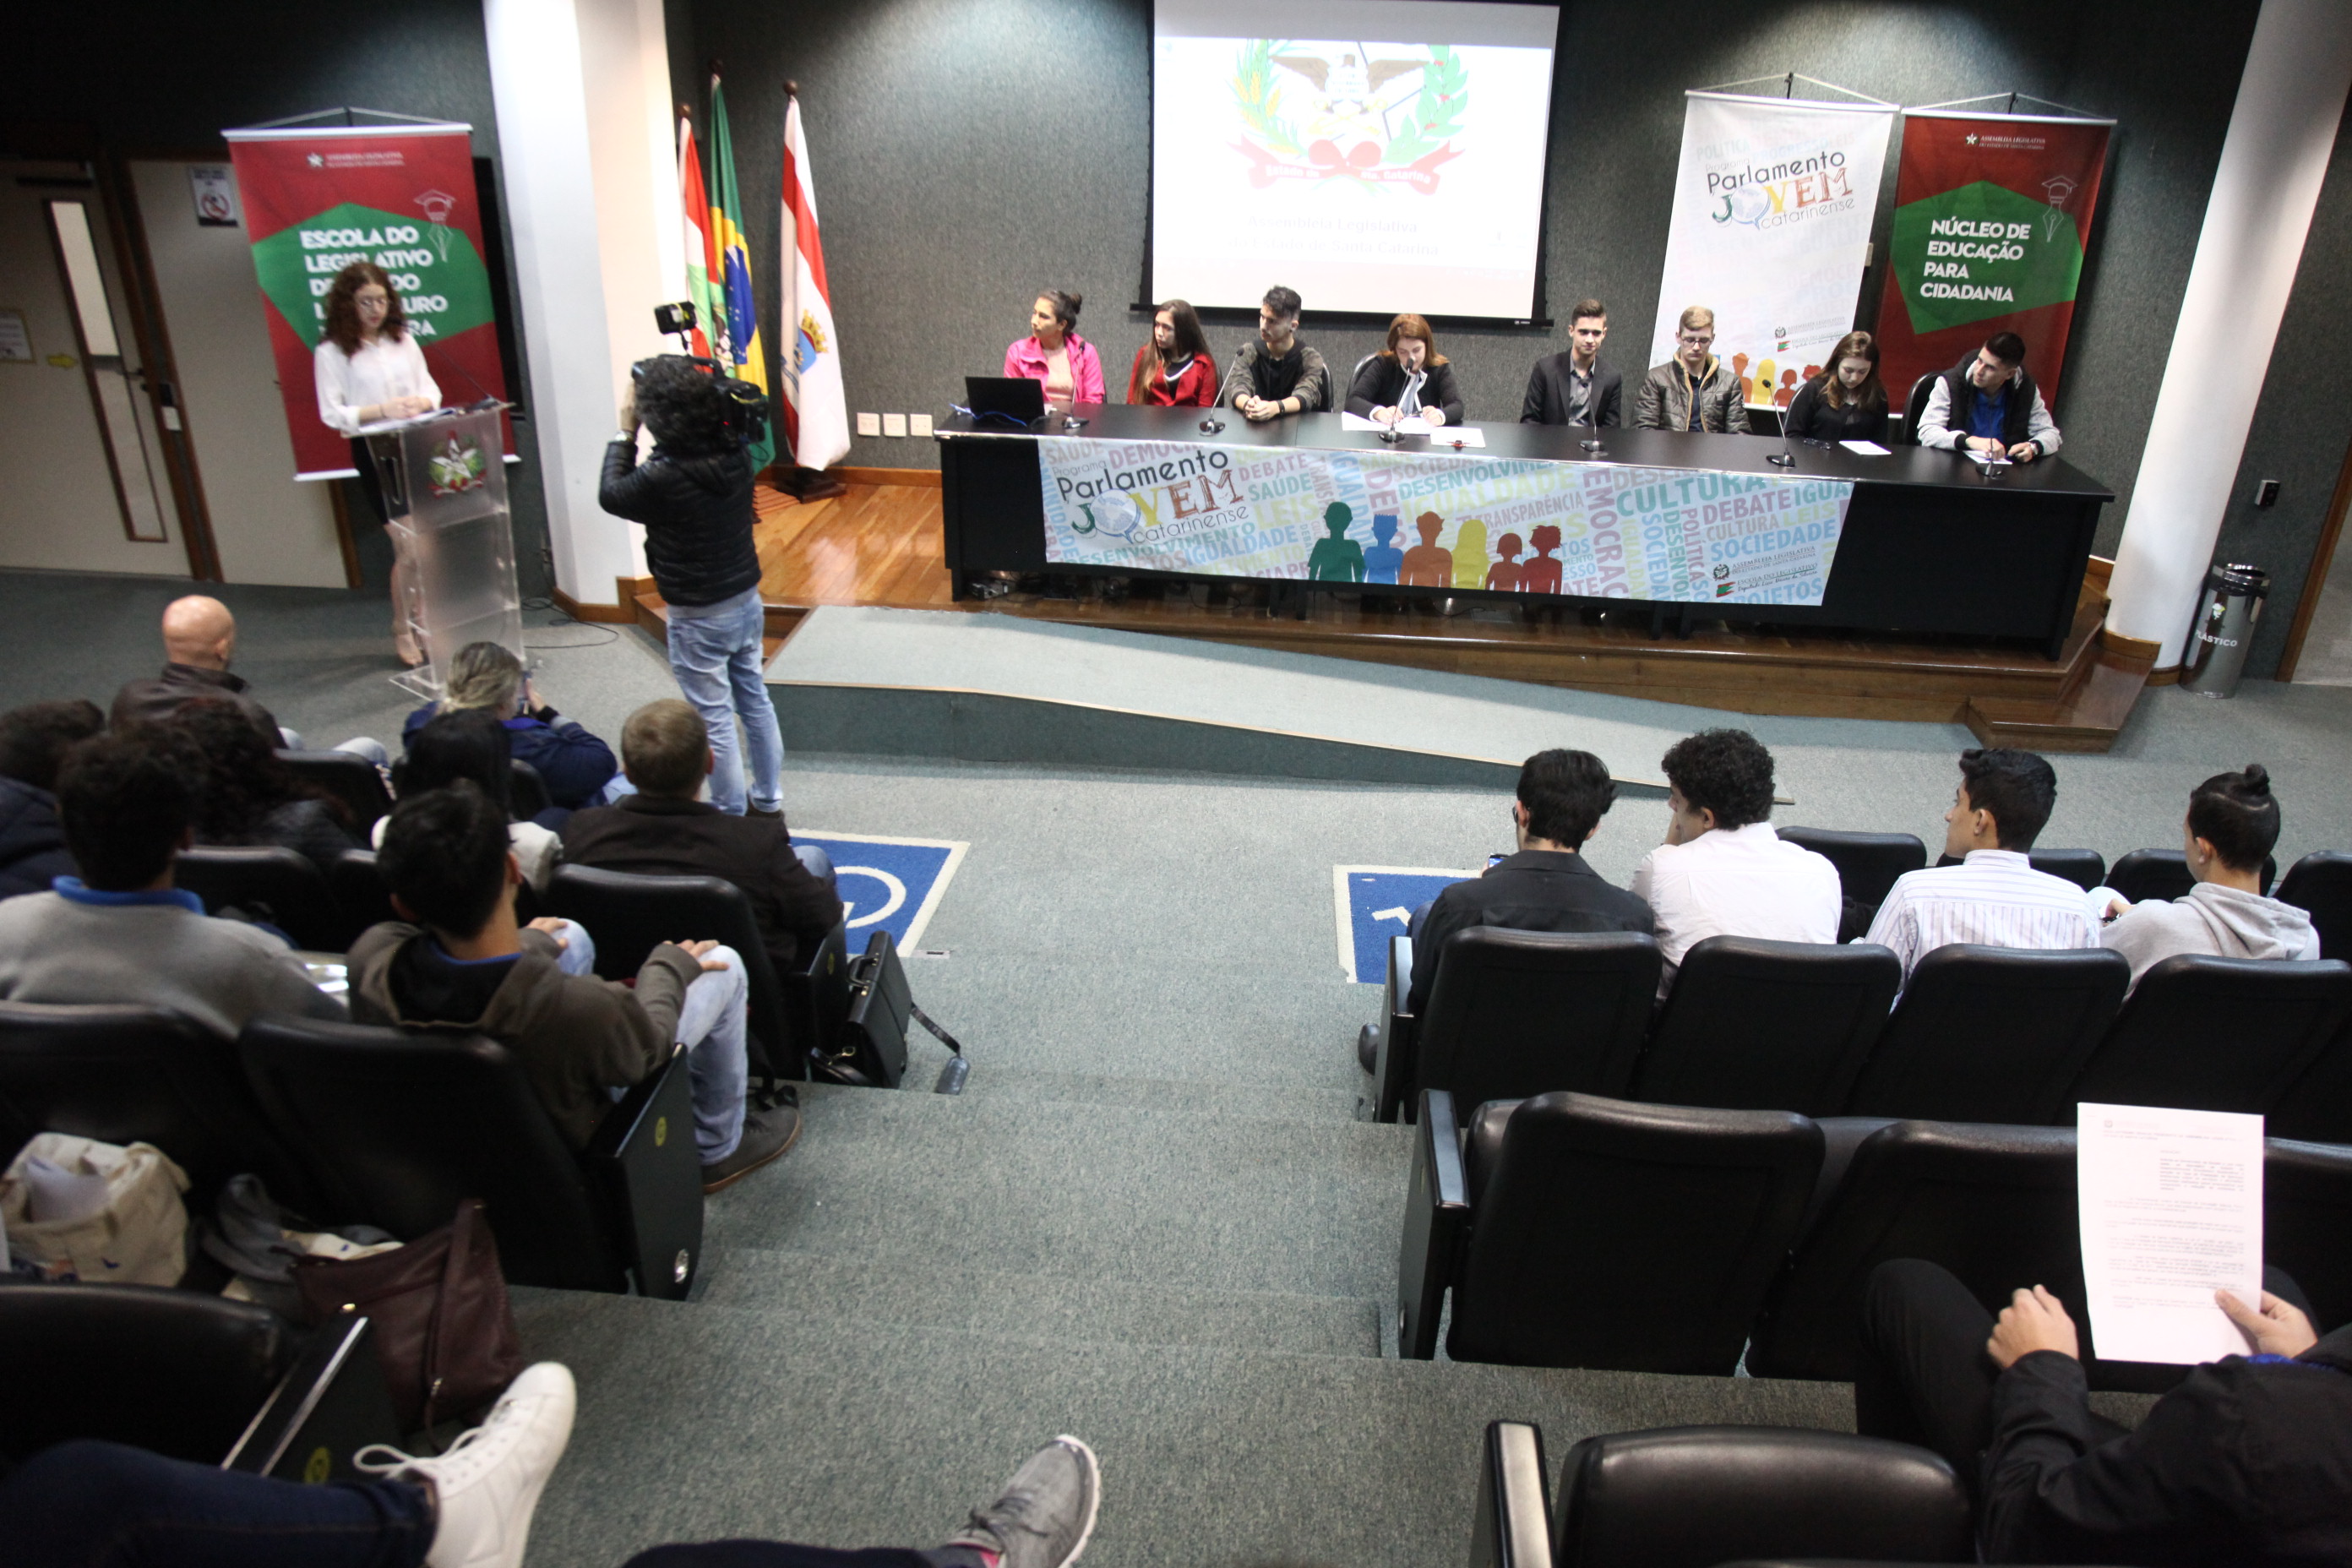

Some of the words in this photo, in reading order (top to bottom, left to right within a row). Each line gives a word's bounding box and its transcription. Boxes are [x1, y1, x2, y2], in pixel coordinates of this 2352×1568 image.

[1707, 150, 1845, 194] Parlamento
[1712, 167, 1854, 226] JOVEM
[1761, 197, 1855, 229] catarinense
[299, 228, 386, 249] ESCOLA
[384, 226, 420, 245] DO
[1247, 215, 1332, 230] Assembleia
[1337, 218, 1418, 234] Legislativa
[1930, 215, 2005, 238] NÚCLEO
[2006, 223, 2032, 240] DE
[1923, 261, 1969, 279] PARA
[1927, 240, 2024, 264] EDUCAÇÃO
[1919, 282, 2014, 302] CIDADANIA
[1052, 459, 1108, 476] Programa
[1057, 449, 1228, 502] Parlamento
[1239, 453, 1310, 482] DEBATE
[1071, 469, 1244, 541] JOVEM
[1248, 472, 1313, 502] SAÚDE
[1616, 473, 1767, 517] CULTURA
[1133, 505, 1250, 544] catarinense
[1255, 493, 1320, 530] LEIS
[1702, 488, 1792, 525] DEBATE
[1707, 515, 1780, 542] CULTURA
[1783, 501, 1837, 528] LEIS
[1184, 525, 1298, 566] IGUALDADE
[1681, 508, 1707, 583] POLÍTICA
[1711, 519, 1836, 563] SOCIEDADE
[1774, 545, 1816, 560] LEGISLATIVA
